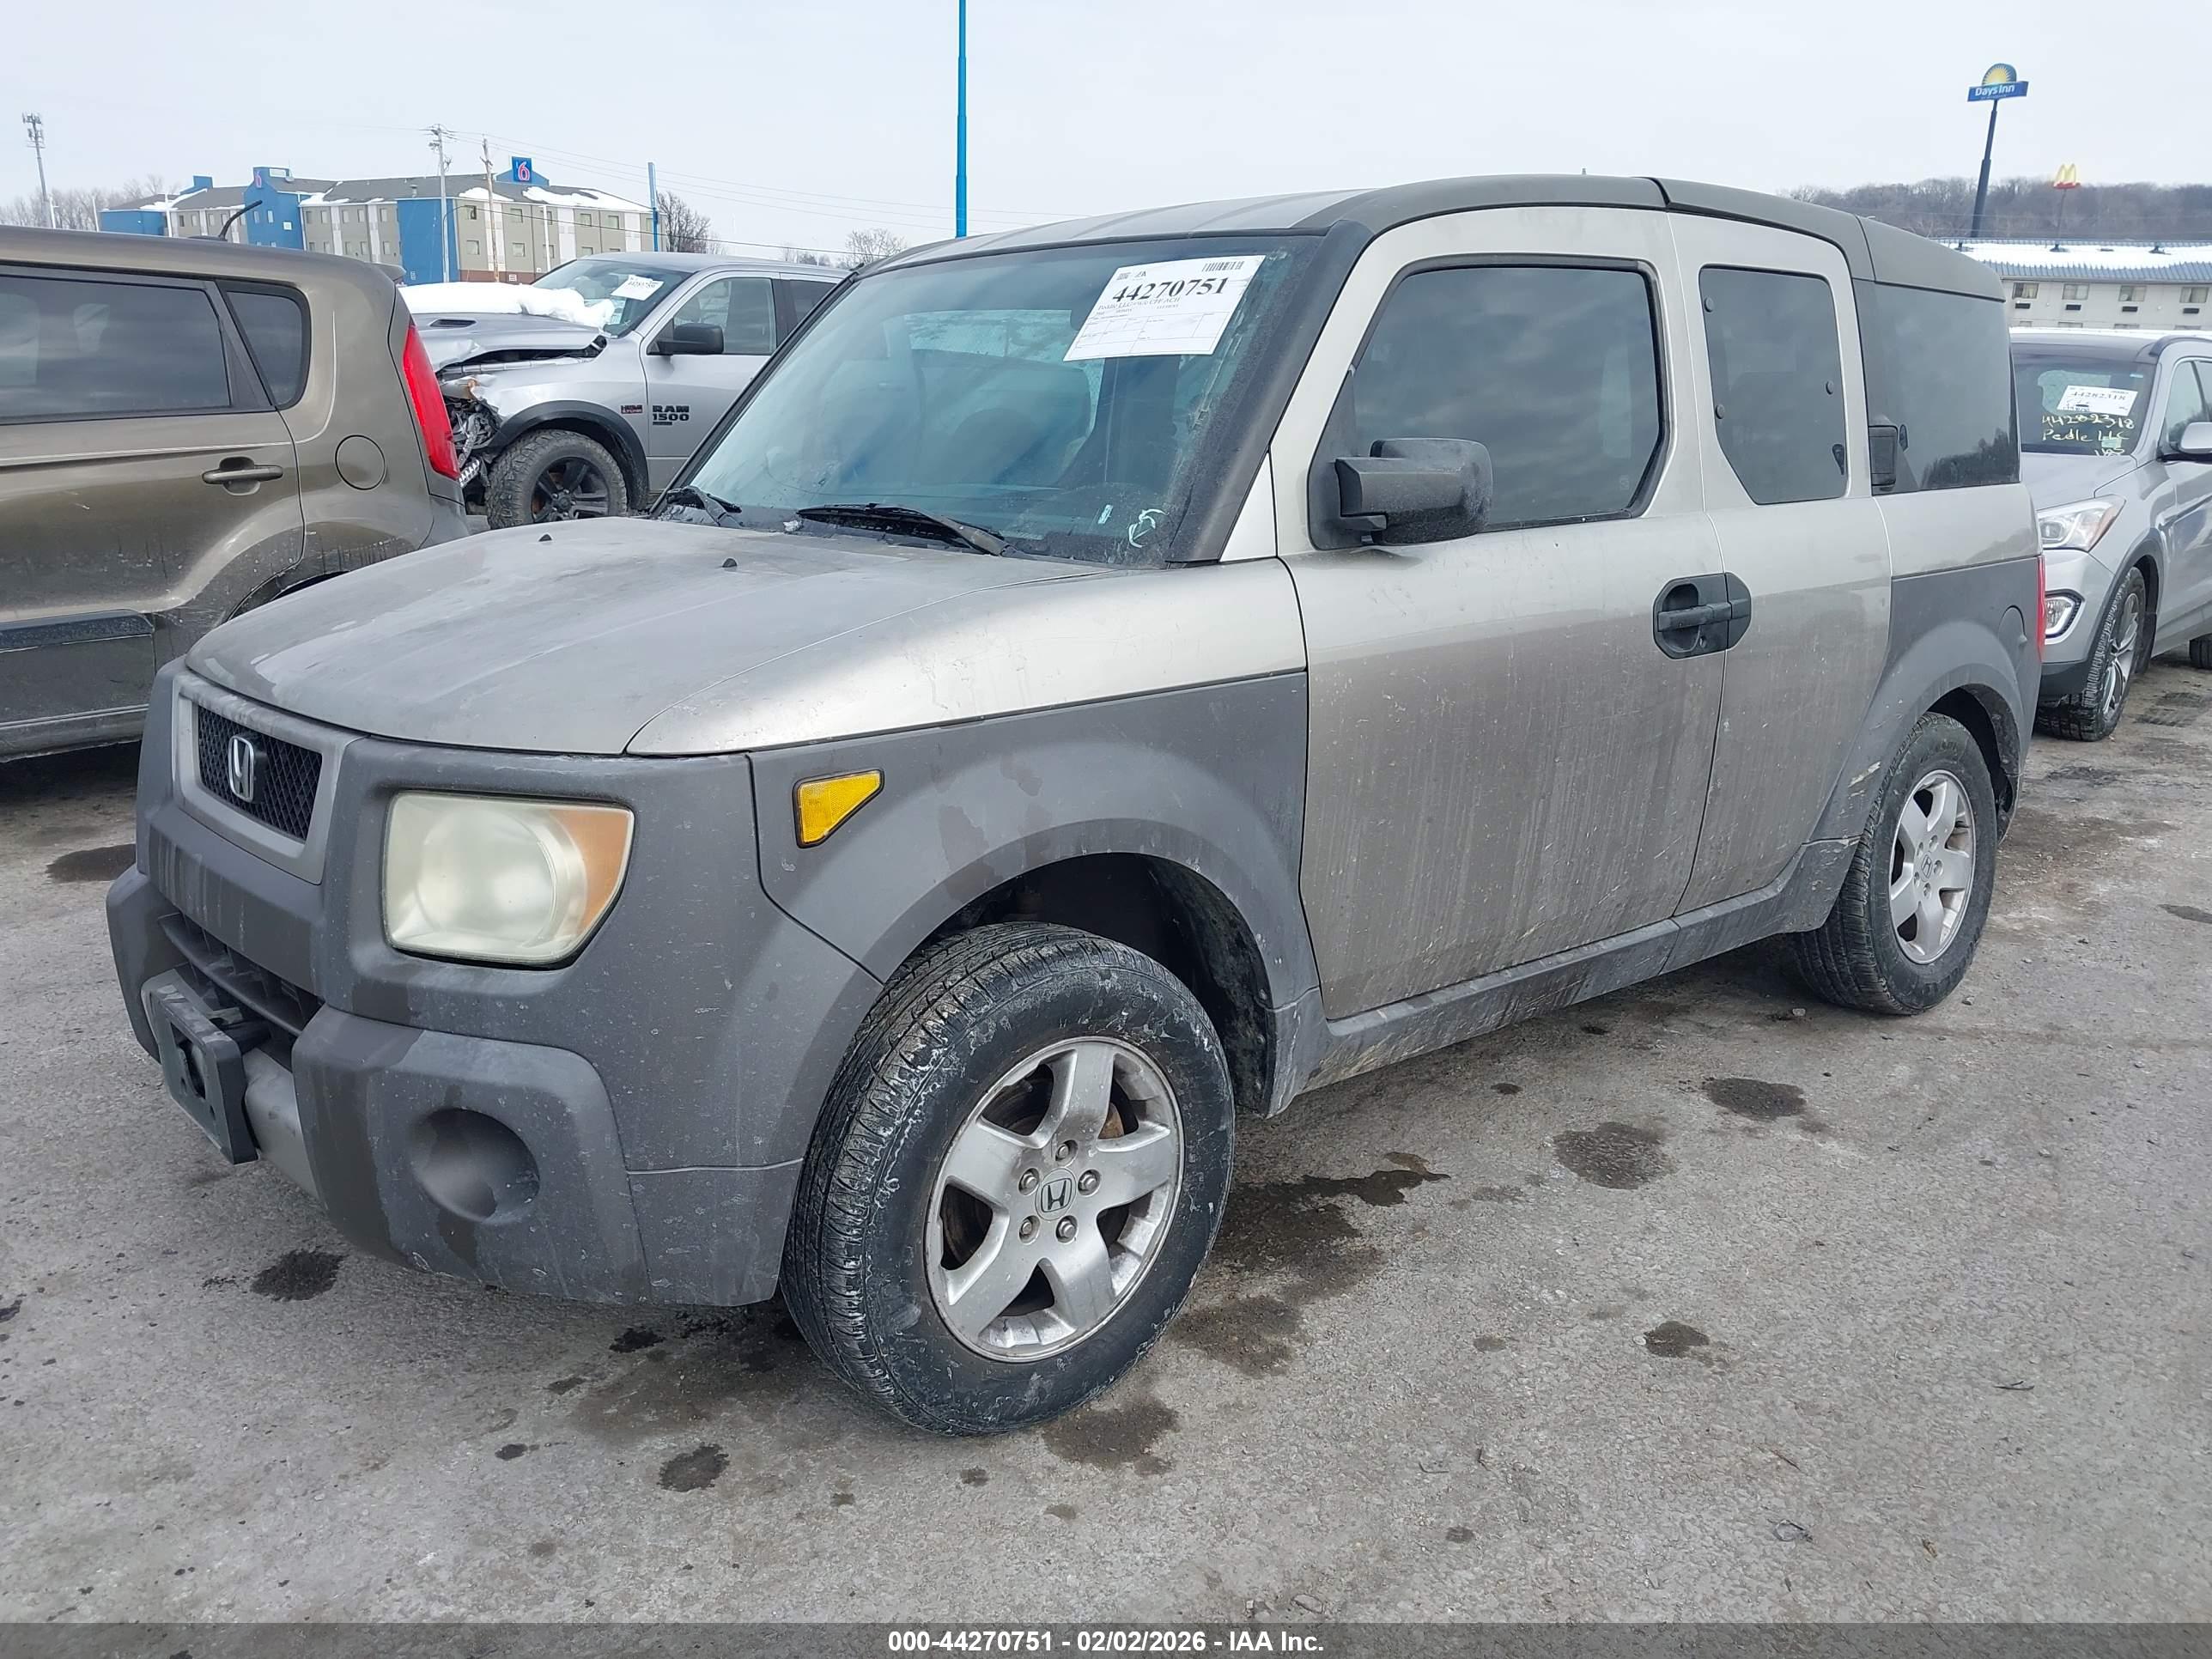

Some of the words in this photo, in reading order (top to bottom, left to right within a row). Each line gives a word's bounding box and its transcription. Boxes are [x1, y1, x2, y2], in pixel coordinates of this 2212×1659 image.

[1975, 87, 1998, 97] Days
[1998, 84, 2015, 94] Inn
[518, 161, 530, 181] 6
[1113, 276, 1230, 302] 44270751
[652, 404, 690, 413] RAM
[652, 413, 690, 422] 1500
[2042, 413, 2136, 429] 44282318
